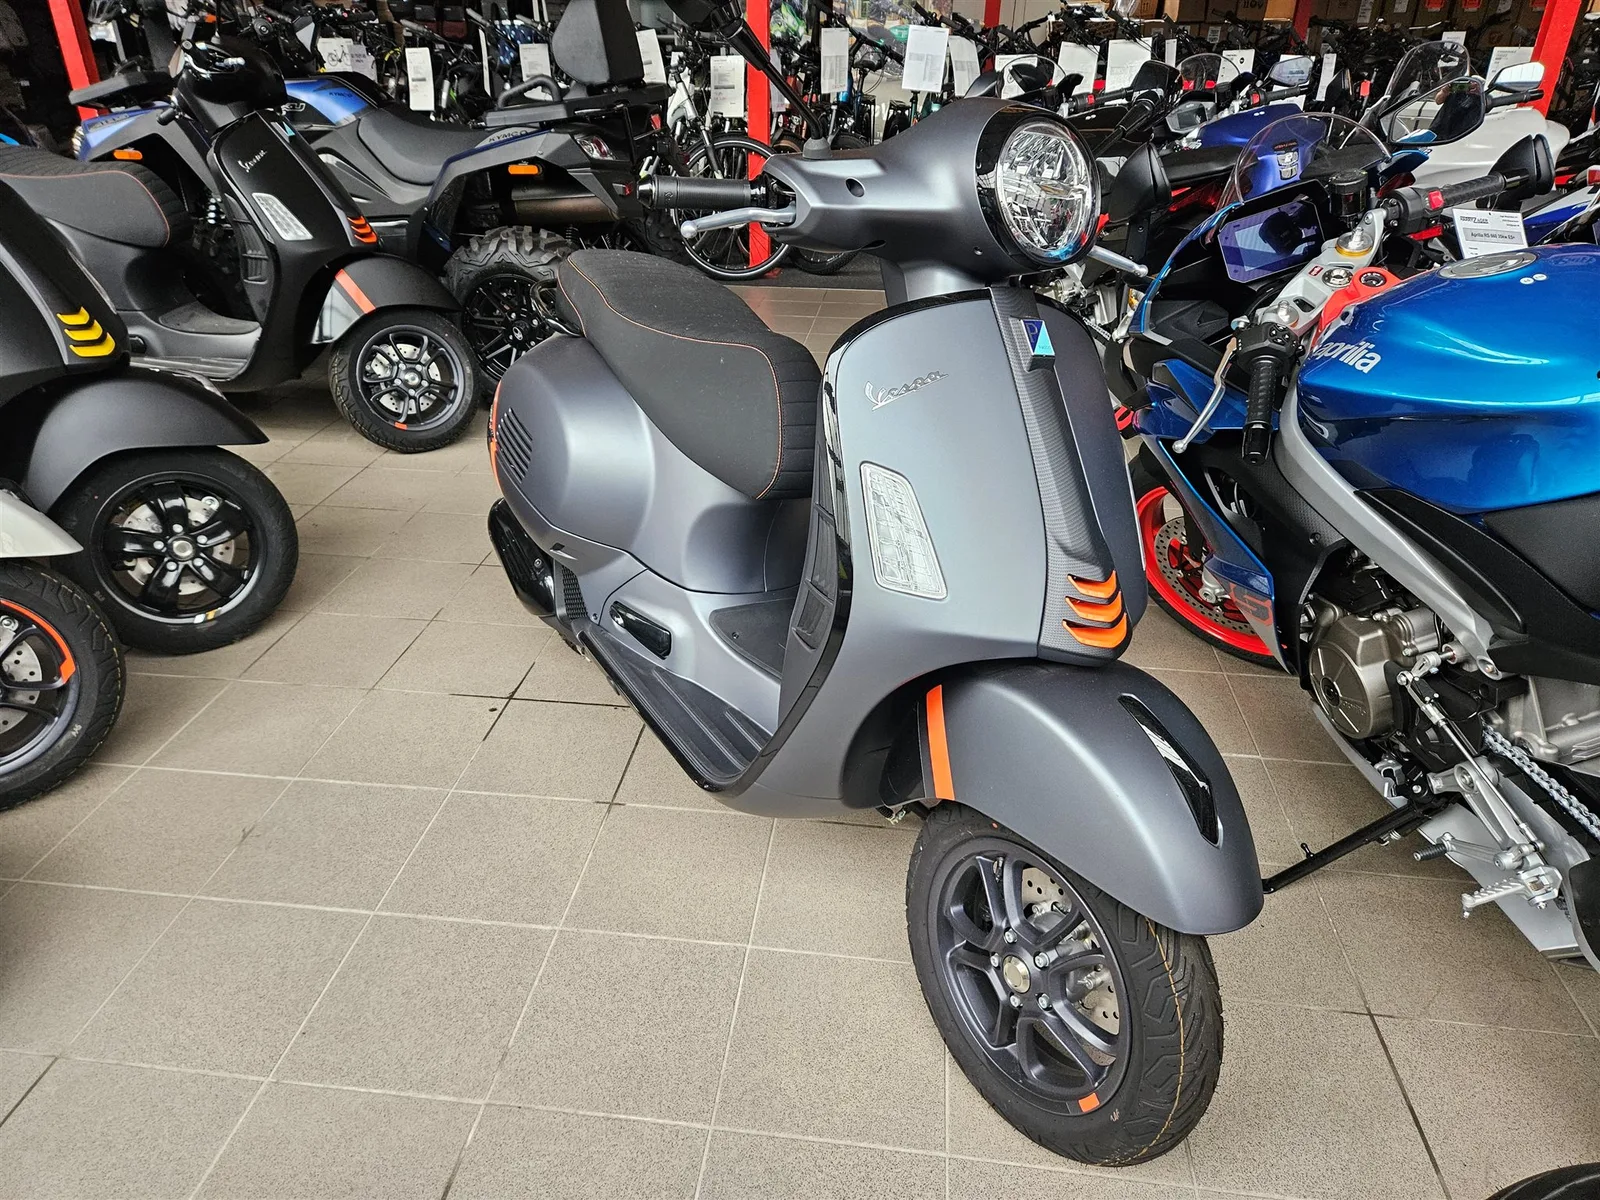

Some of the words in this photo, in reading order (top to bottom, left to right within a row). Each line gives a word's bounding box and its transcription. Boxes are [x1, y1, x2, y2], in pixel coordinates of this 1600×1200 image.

[489, 130, 528, 142] KYMCO
[1313, 341, 1381, 374] aprilia
[864, 371, 949, 412] Vespa
